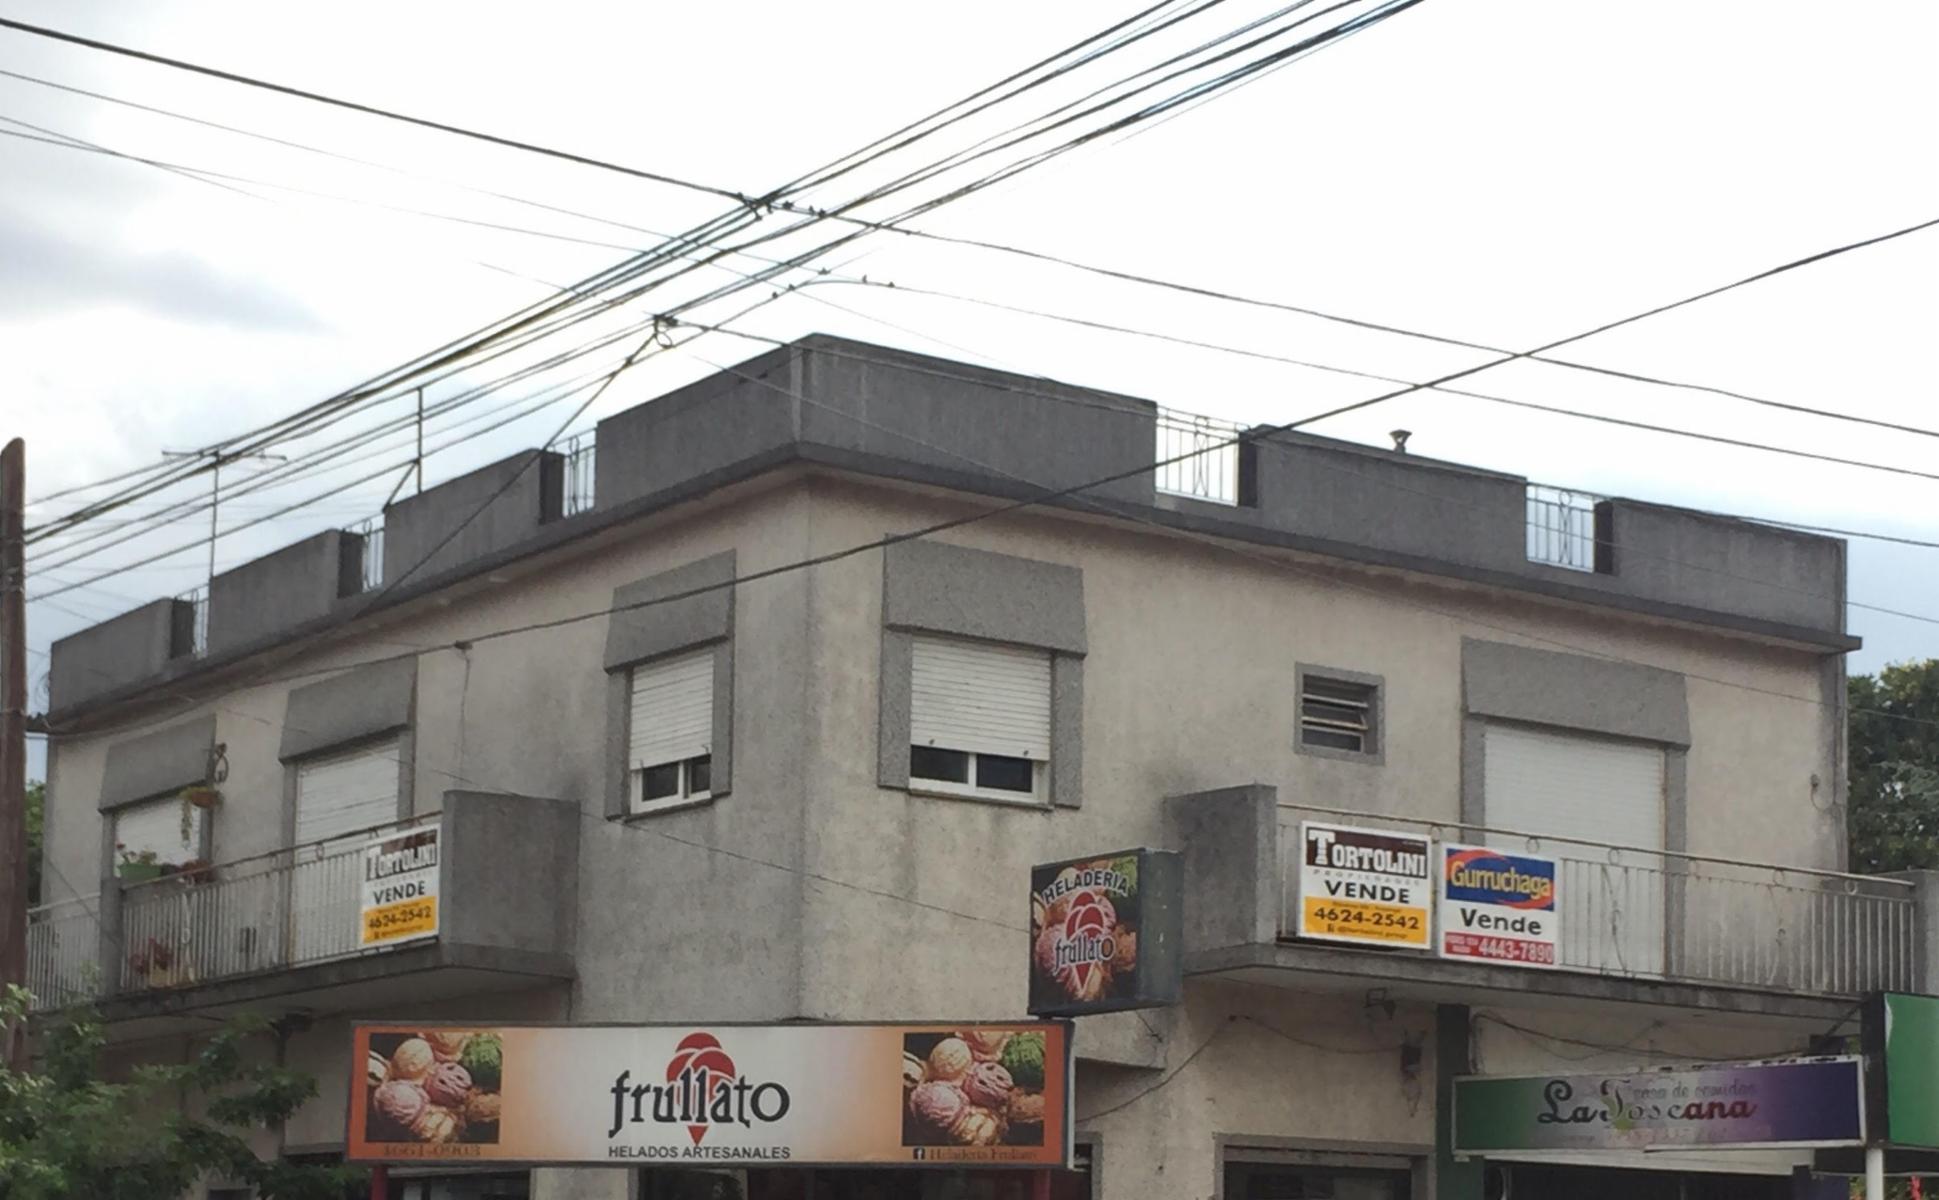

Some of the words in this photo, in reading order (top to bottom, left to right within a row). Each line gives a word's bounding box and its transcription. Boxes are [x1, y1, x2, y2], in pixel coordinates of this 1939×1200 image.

[1308, 829, 1427, 878] TORTOLINI
[373, 881, 425, 904] VENDE
[1042, 868, 1129, 904] HELADERIA
[1324, 879, 1410, 904] VENDE
[1451, 861, 1550, 899] Gurruchaga
[368, 905, 431, 928] 4624-2542
[1314, 907, 1419, 930] 4624-2542
[1460, 908, 1542, 935] Vende
[1053, 933, 1115, 976] frullato
[608, 1065, 791, 1139] frullato
[1537, 1079, 1598, 1124] La
[1599, 1079, 1757, 1122] Toscana
[608, 1145, 679, 1159] HELADOS
[682, 1146, 791, 1160] ARTESANALES
